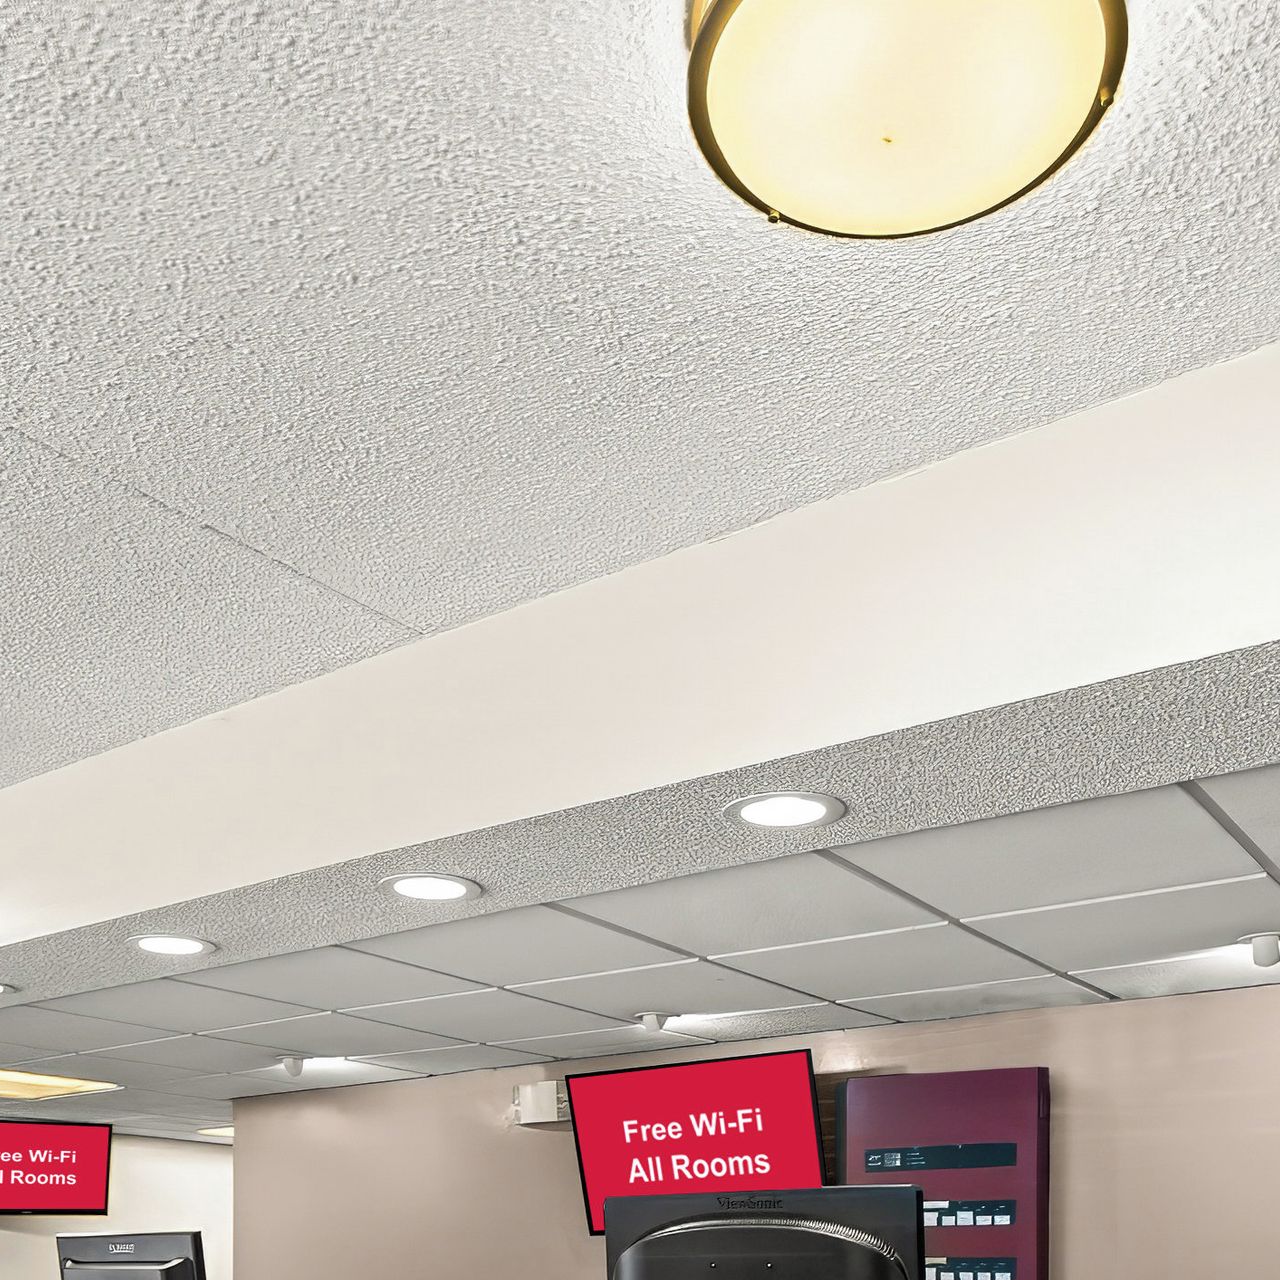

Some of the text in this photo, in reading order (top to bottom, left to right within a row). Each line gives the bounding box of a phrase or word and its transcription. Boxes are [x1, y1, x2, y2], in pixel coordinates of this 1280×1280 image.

[622, 1107, 763, 1144] Free Wi-Fi
[28, 1149, 77, 1164] Wi-Fi
[10, 1169, 77, 1185] Rooms
[628, 1153, 771, 1184] All Rooms
